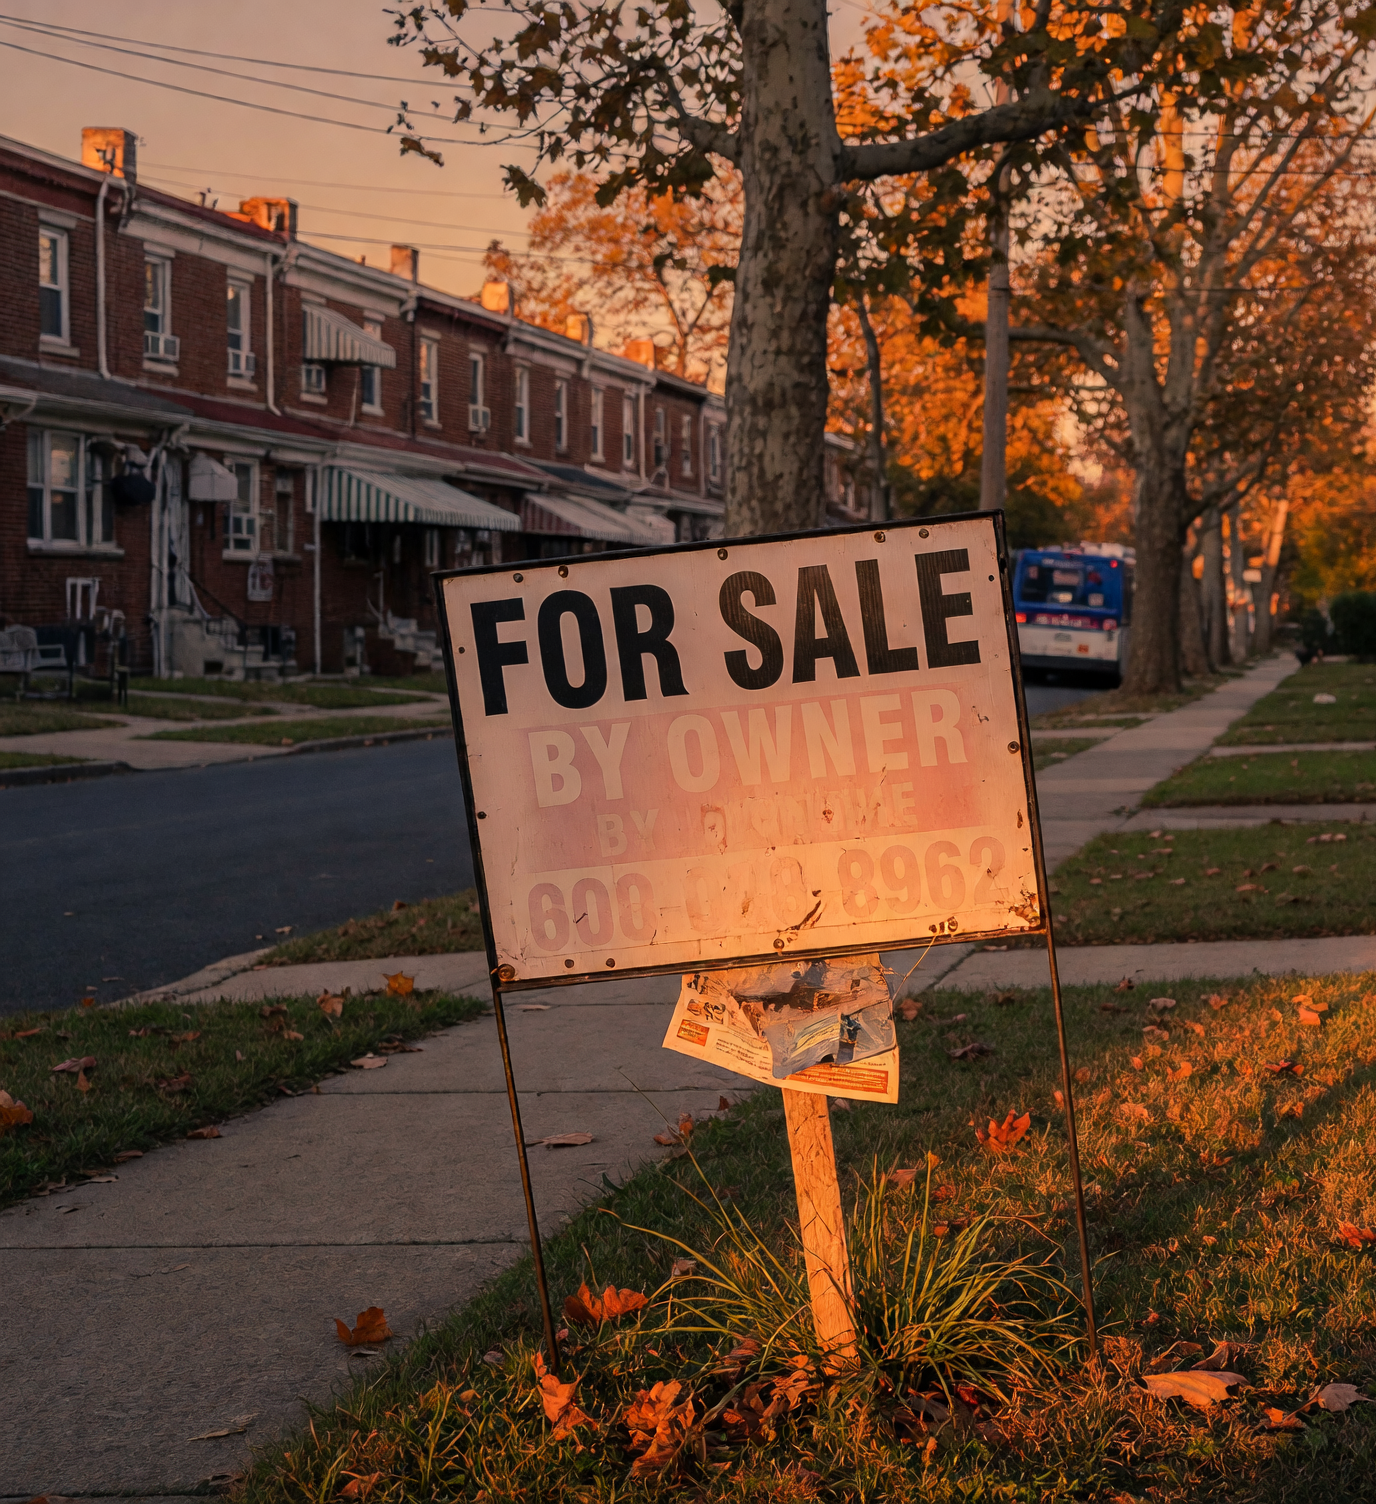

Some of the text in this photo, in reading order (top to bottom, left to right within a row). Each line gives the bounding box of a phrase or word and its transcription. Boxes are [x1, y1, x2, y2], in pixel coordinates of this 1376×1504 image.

[470, 548, 982, 717] FOR SALE
[527, 688, 969, 809] BY OWNER
